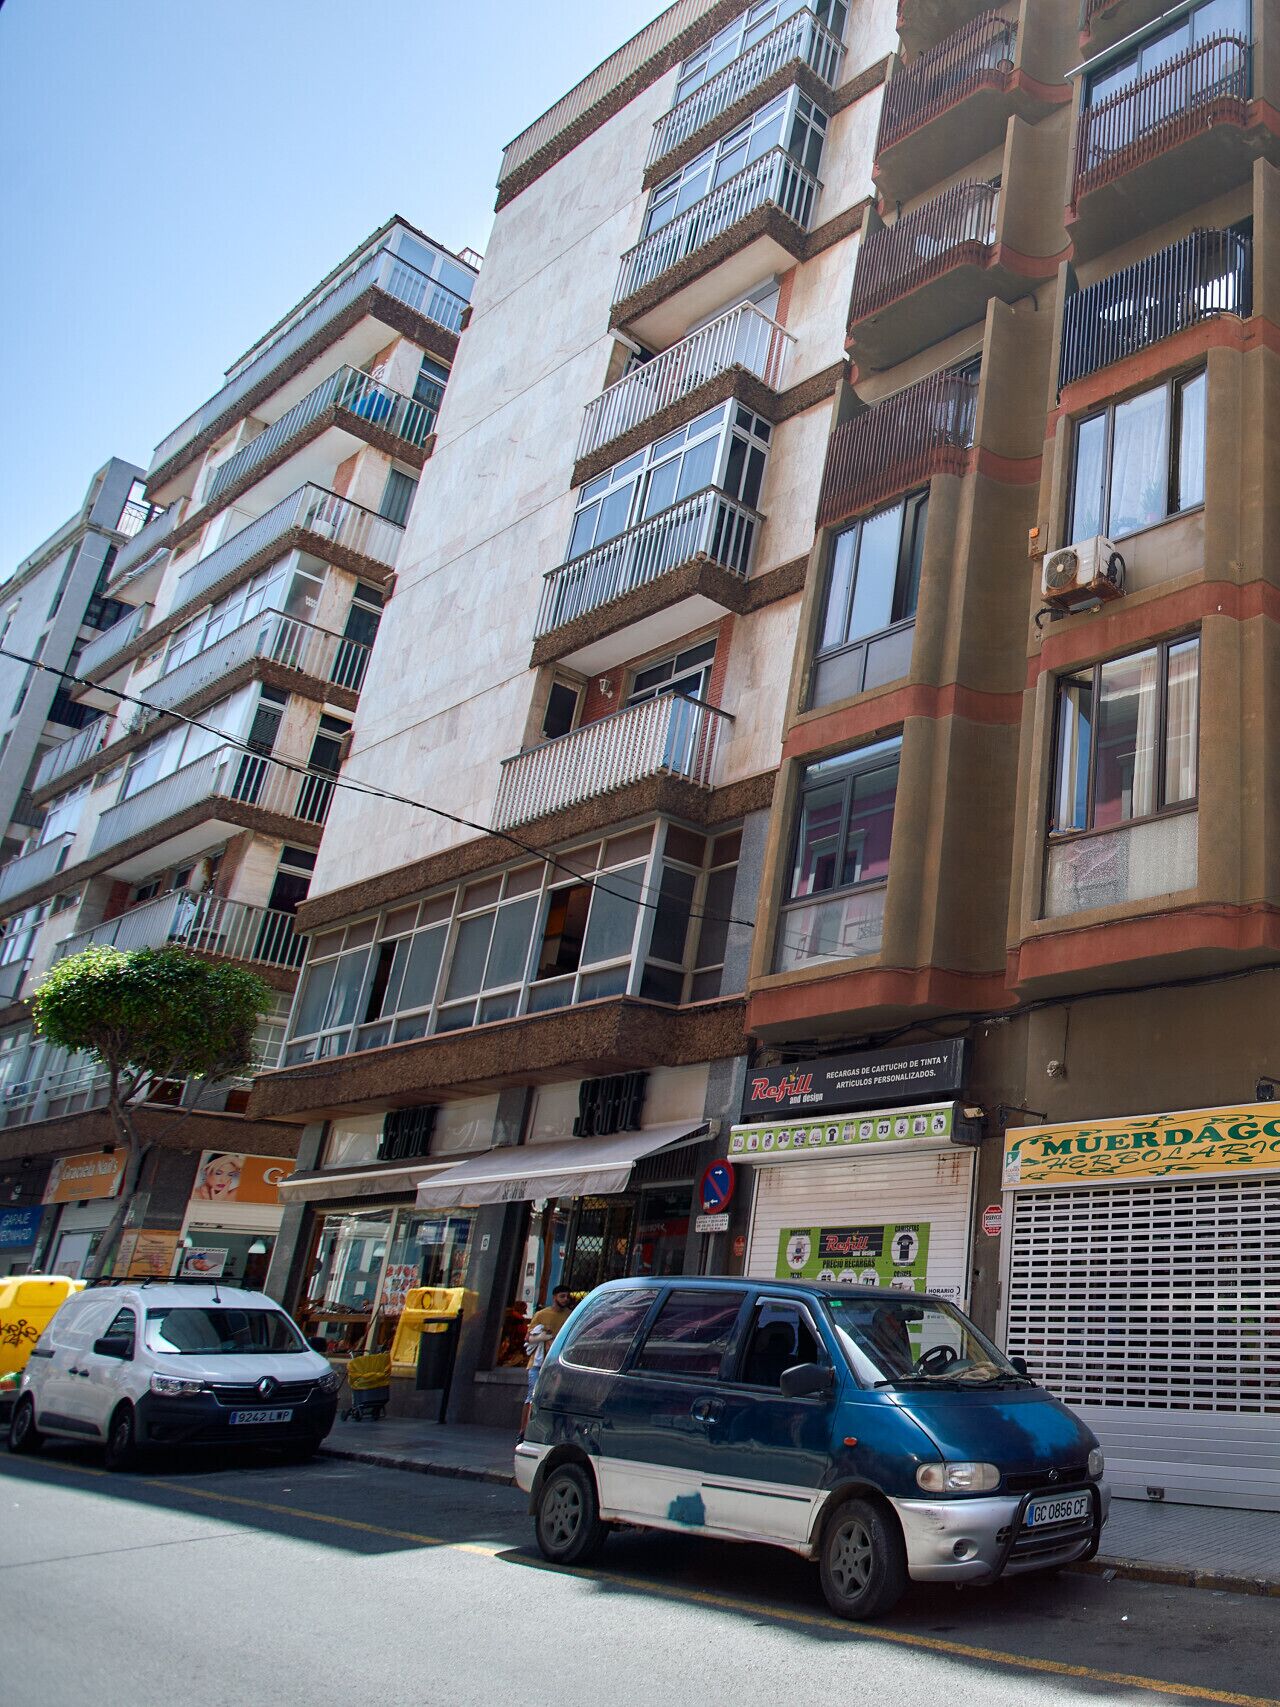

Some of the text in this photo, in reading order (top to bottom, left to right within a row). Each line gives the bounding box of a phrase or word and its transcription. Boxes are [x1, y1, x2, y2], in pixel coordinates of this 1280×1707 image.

[826, 1055, 949, 1079] RECARGAS DE CARTUCHO DE TINTA Y
[751, 1072, 813, 1102] Refill
[836, 1069, 937, 1089] ARTÍCULOS PERSONALIZADOS.
[789, 1092, 824, 1105] and design
[826, 1235, 869, 1255] Refill
[822, 1258, 876, 1268] PRECIO RECARGAS
[239, 1412, 267, 1423] 9242
[1034, 1498, 1087, 1523] GC 0856 CF
